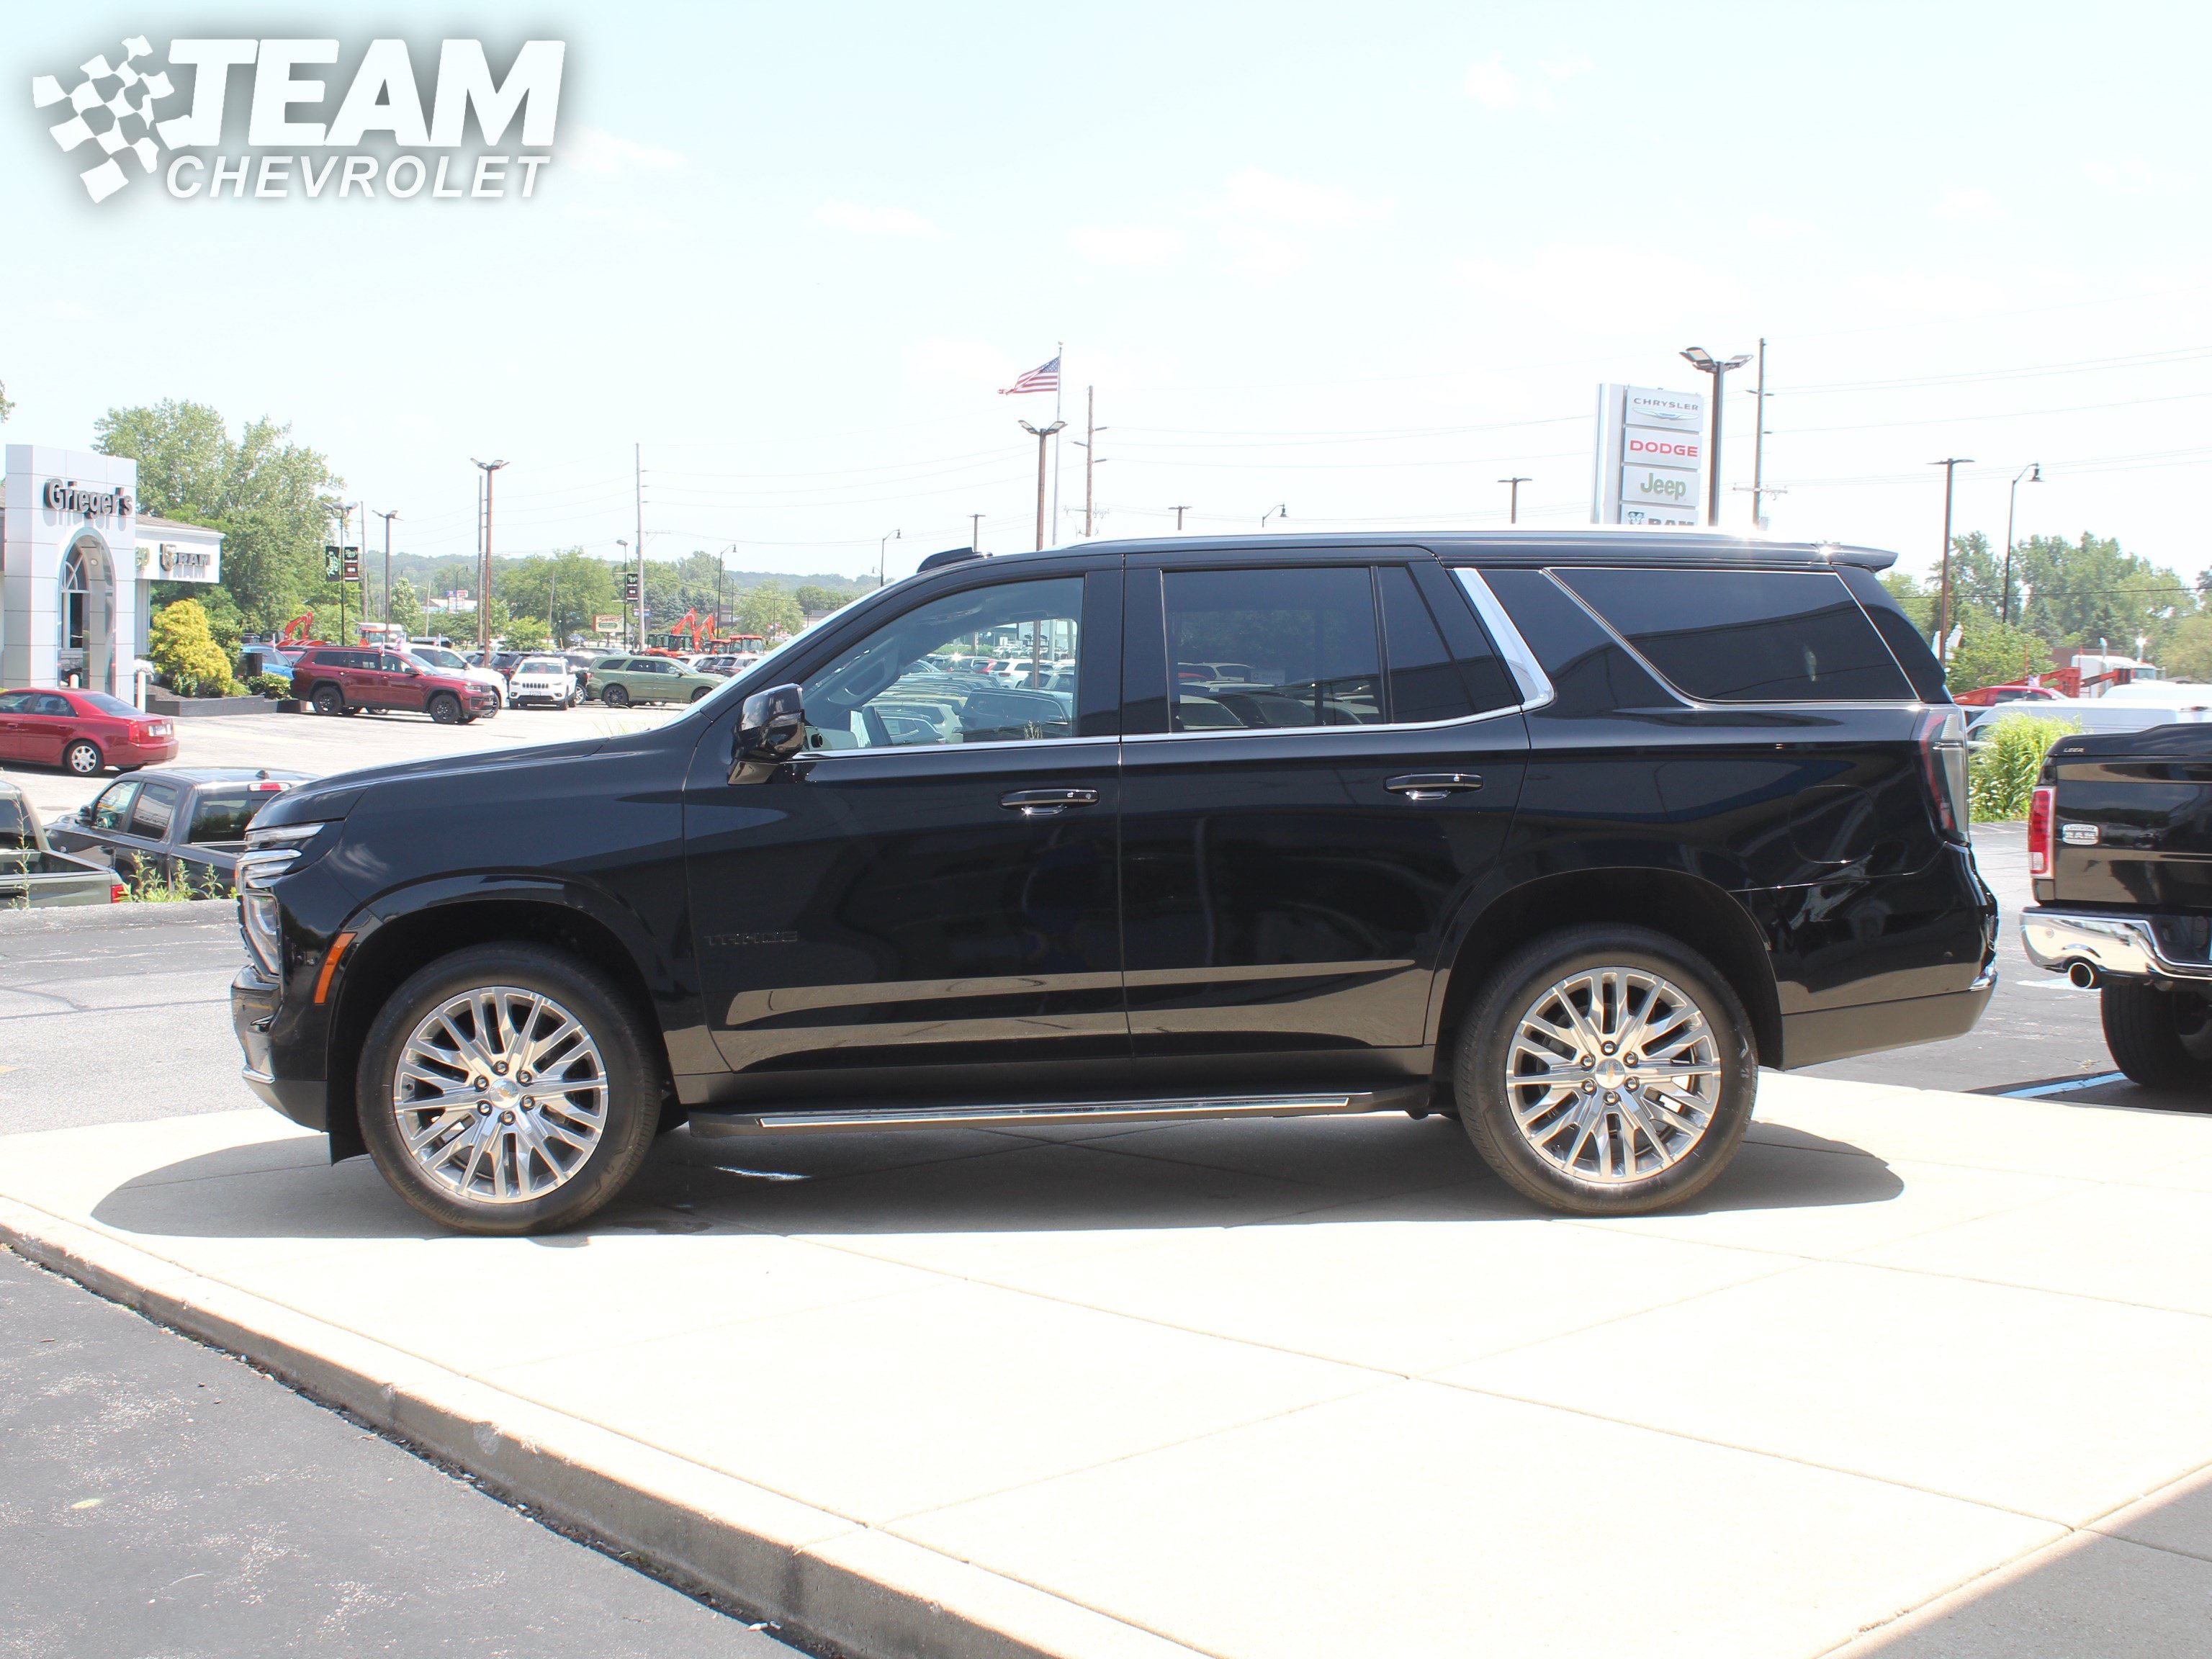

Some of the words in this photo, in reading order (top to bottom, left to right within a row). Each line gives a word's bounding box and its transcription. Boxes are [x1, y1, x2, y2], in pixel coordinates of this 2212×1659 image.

[1633, 397, 1699, 410] CHRYSLER
[1629, 439, 1699, 458] DODGE
[1640, 472, 1686, 501] Jeep
[45, 477, 133, 520] Grieger's
[177, 552, 211, 566] RAM
